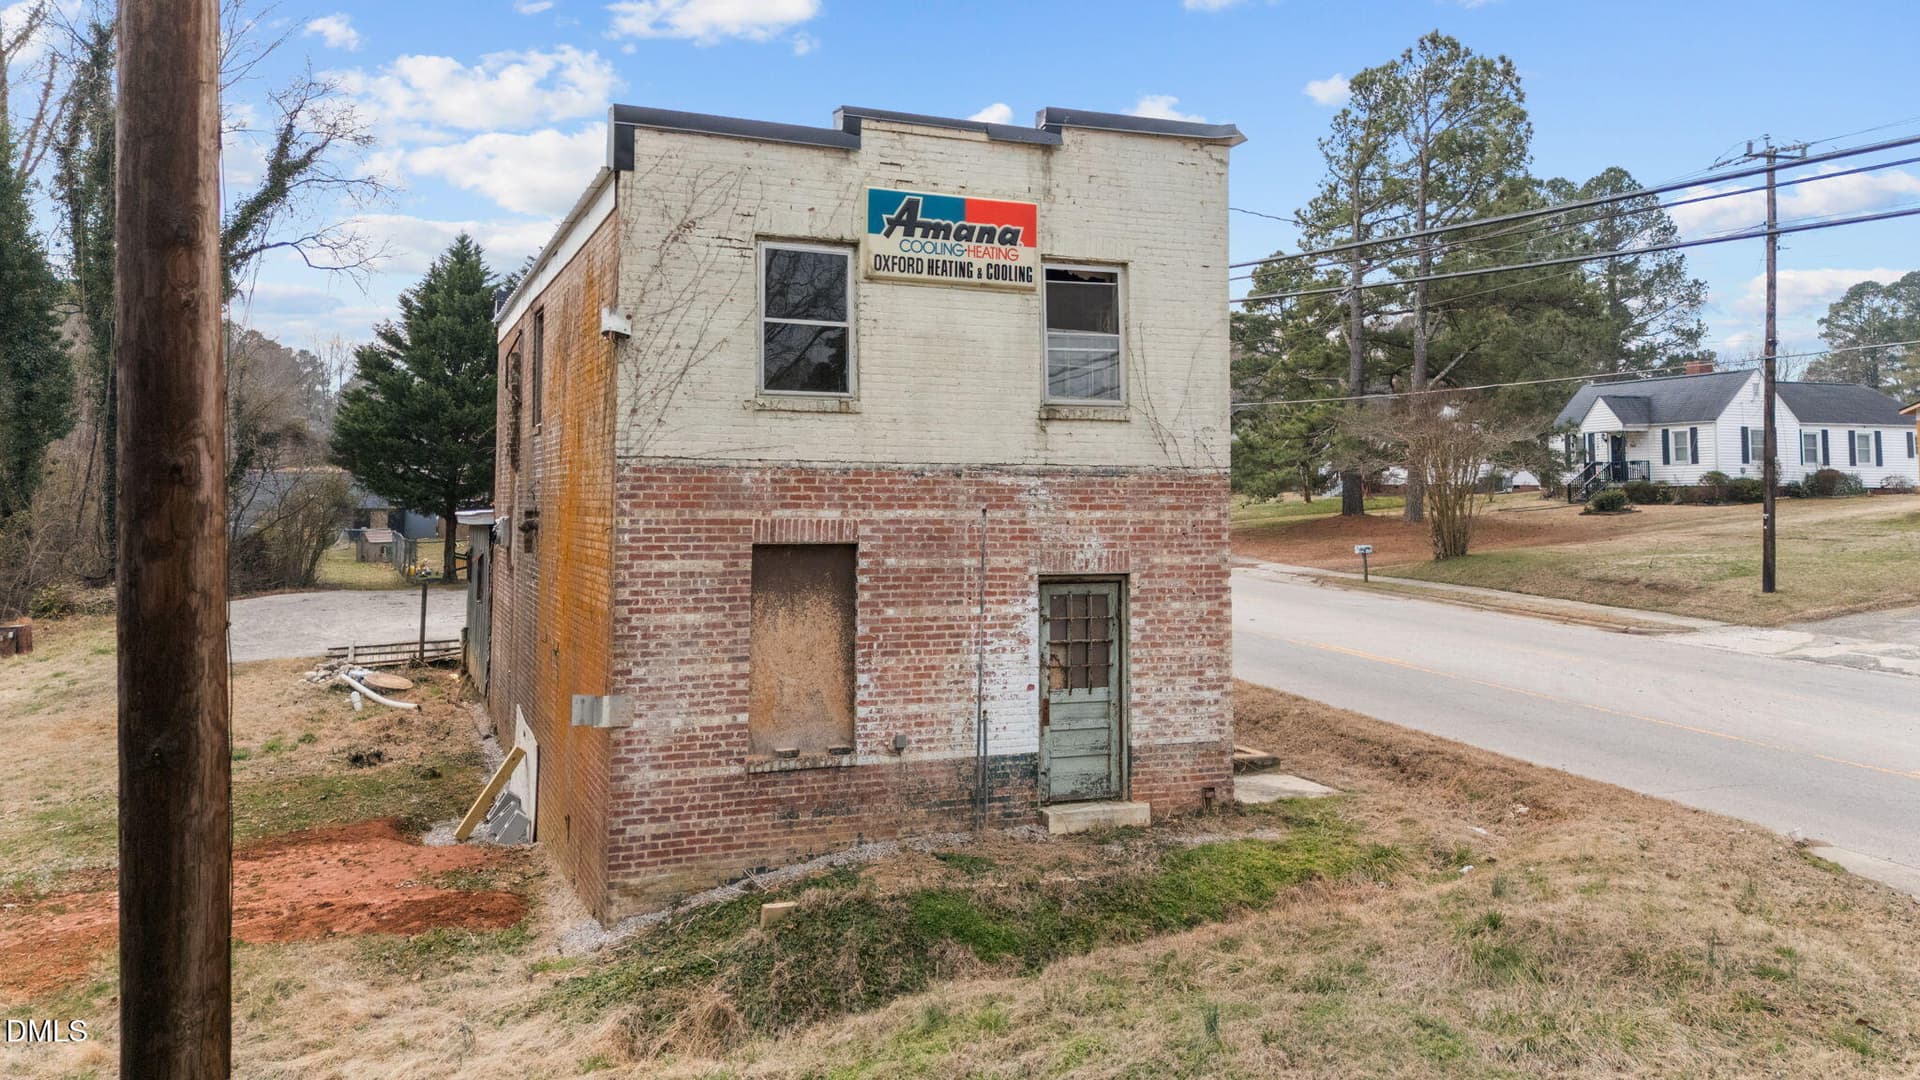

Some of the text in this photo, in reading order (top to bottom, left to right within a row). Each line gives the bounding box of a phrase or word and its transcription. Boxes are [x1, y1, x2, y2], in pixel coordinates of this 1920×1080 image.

[884, 197, 1022, 247] Amana
[874, 254, 1033, 283] OXFORD HEATING & COOLING
